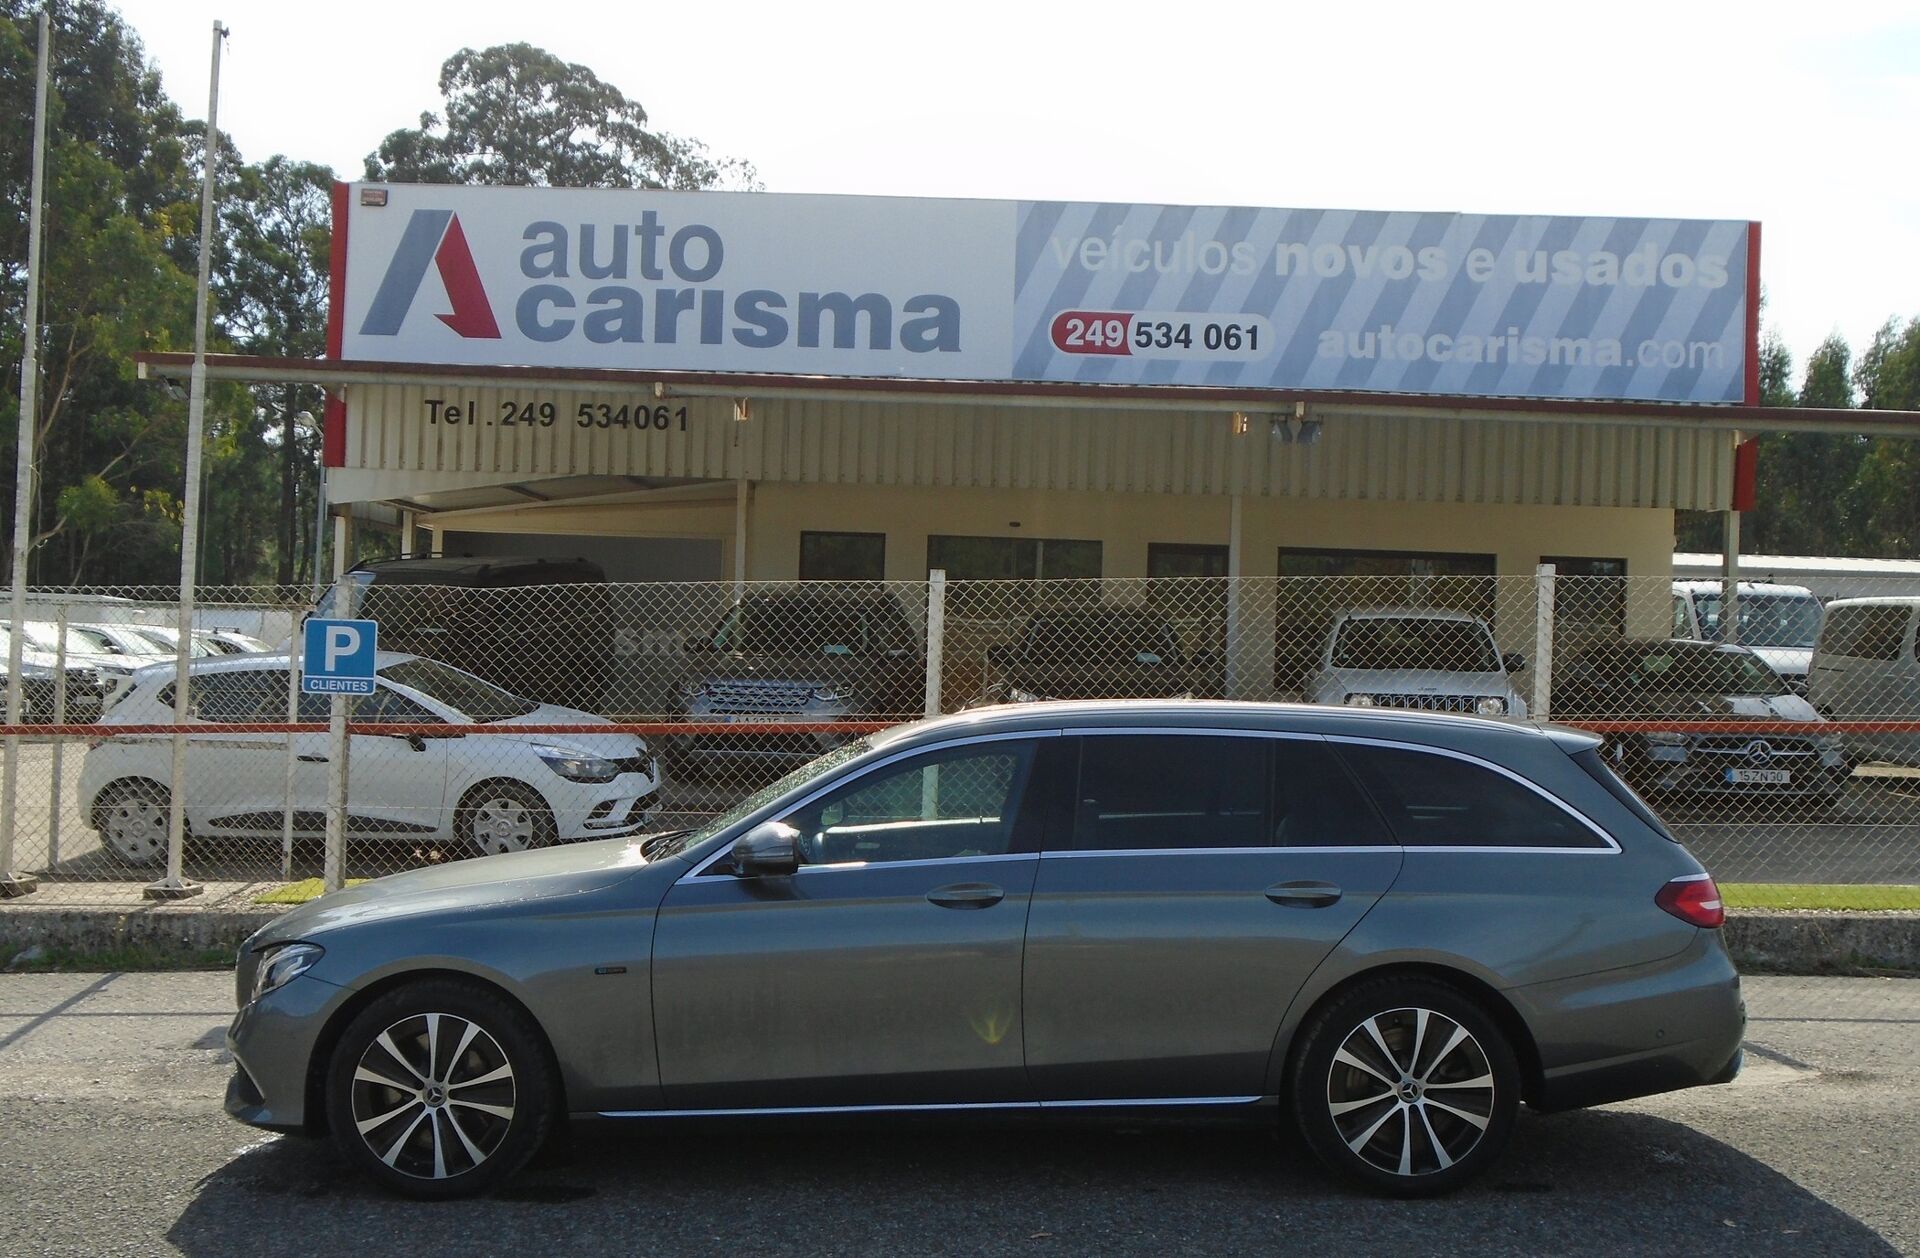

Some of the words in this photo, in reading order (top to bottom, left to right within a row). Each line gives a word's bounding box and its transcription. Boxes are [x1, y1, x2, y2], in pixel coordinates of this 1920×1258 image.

[519, 210, 724, 282] auto
[1051, 224, 1257, 275] veículos
[1275, 242, 1448, 281] novos
[1466, 247, 1495, 283] e
[1515, 242, 1728, 288] usados
[515, 284, 961, 353] carisma
[1065, 318, 1124, 348] 249
[1134, 321, 1193, 349] 534
[1203, 323, 1259, 351] 061
[1317, 323, 1725, 369] autocarisma.com
[576, 403, 688, 431] 534061
[325, 625, 360, 672] P
[310, 679, 368, 692] CLIENTES
